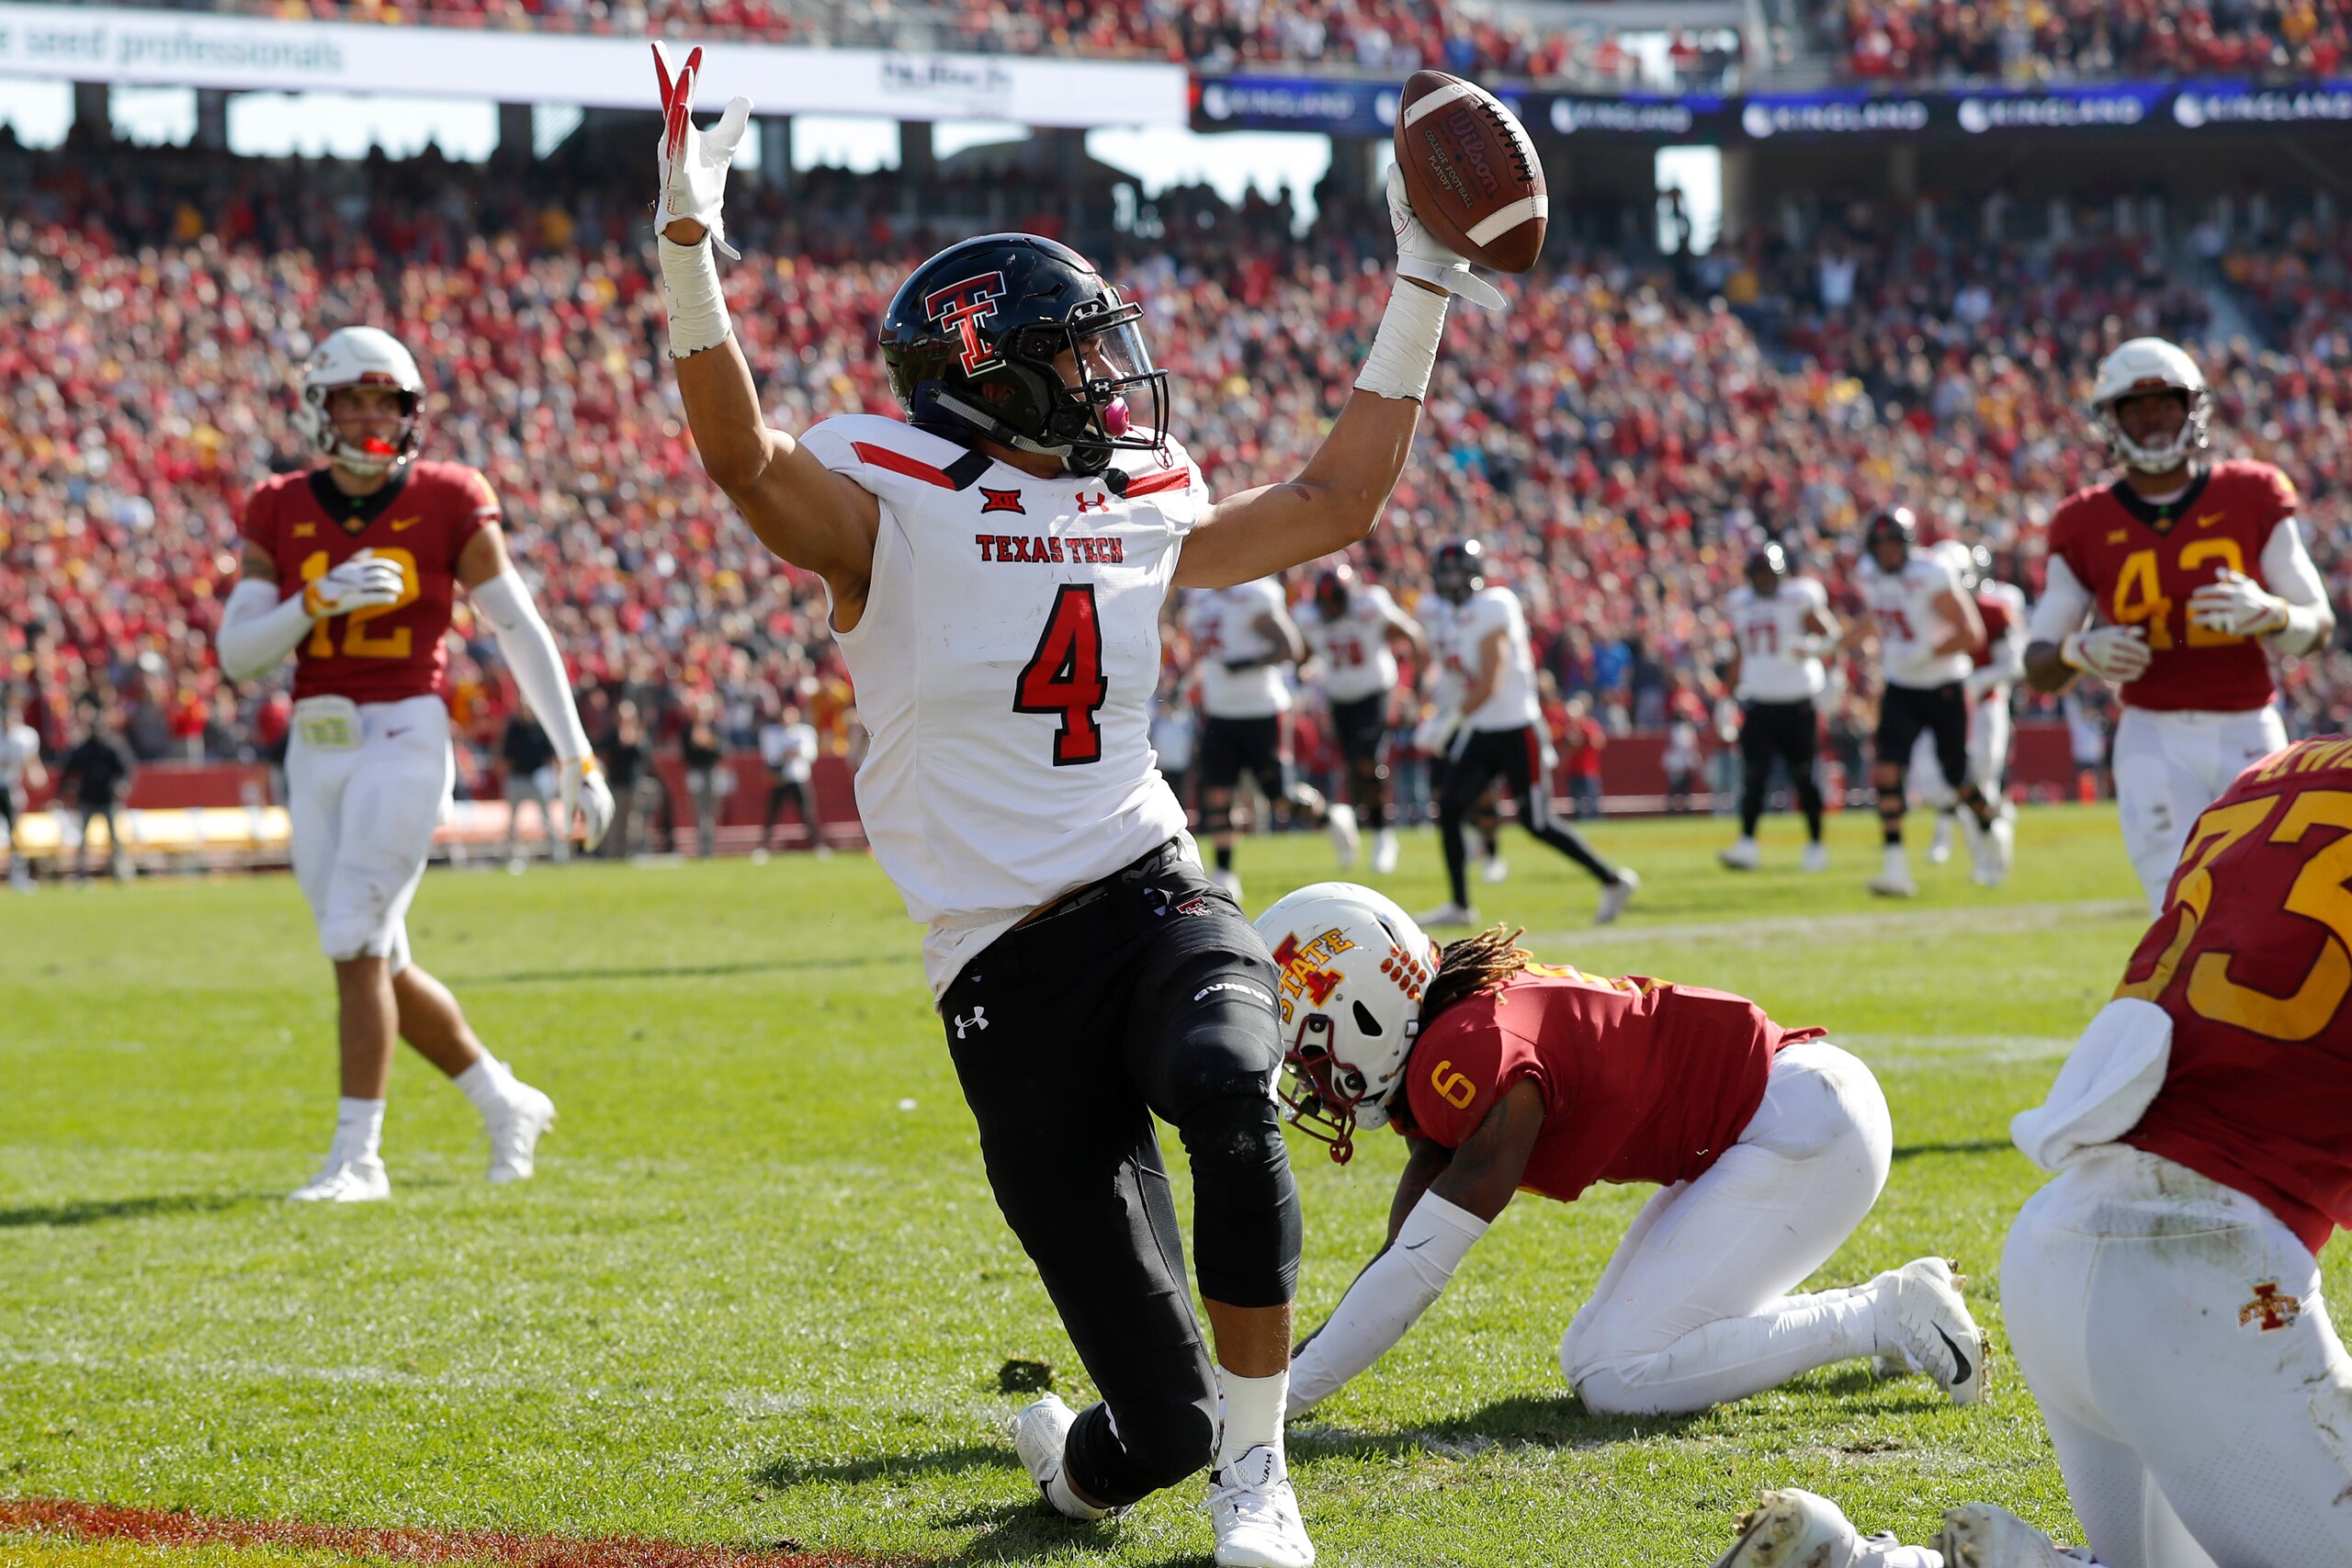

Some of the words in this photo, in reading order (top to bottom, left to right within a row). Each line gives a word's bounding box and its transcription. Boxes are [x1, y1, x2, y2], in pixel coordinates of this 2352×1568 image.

[26, 28, 107, 62] seed
[119, 31, 345, 73] professionals
[1425, 130, 1449, 166] COLLEGE
[1445, 164, 1473, 209] FOOTBALL
[1428, 154, 1453, 191] PLAYOFF
[1448, 108, 1500, 200] Wilson
[976, 535, 1065, 563] TEXAS
[1066, 537, 1124, 564] TECH
[300, 547, 420, 659] 12
[2114, 537, 2246, 650] 42
[1012, 583, 1108, 767] 4
[1430, 1060, 1476, 1110] 6
